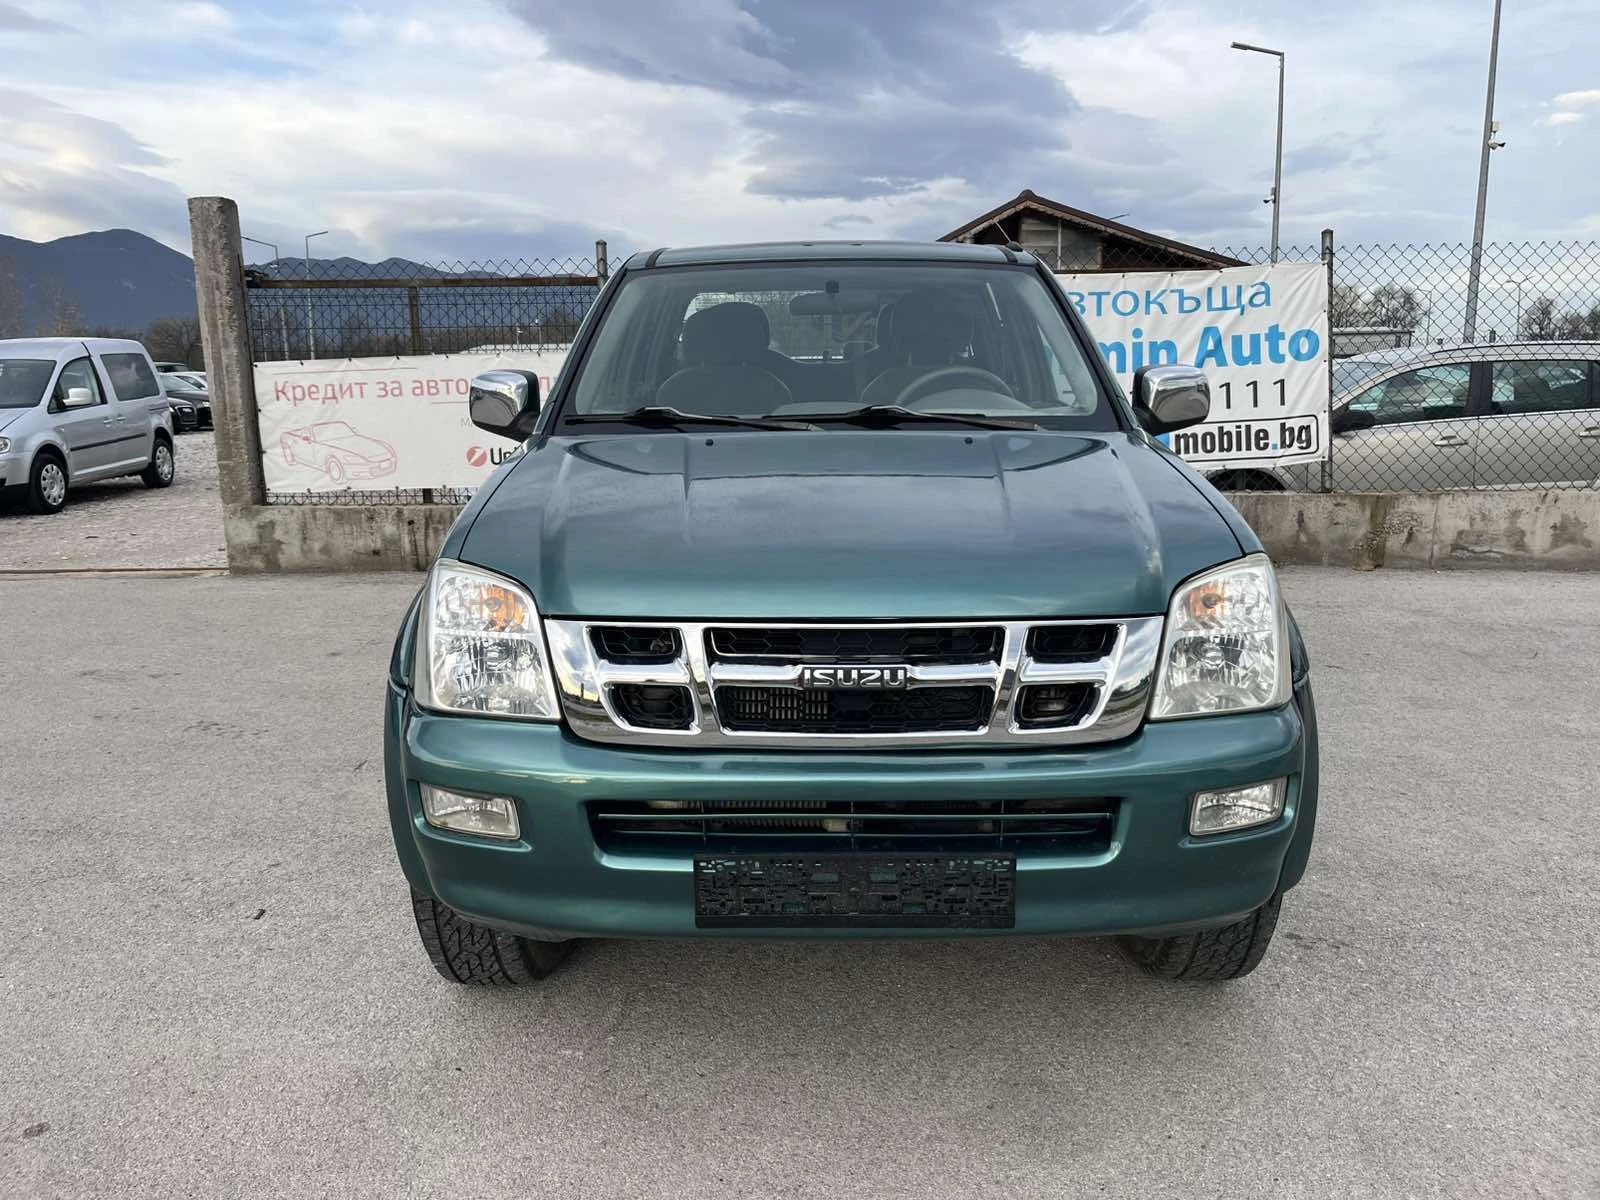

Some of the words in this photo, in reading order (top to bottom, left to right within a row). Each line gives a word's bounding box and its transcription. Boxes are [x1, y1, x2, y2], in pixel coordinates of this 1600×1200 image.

[1194, 324, 1320, 369] Auto
[274, 379, 369, 408] Кредит
[376, 381, 404, 398] за
[1174, 422, 1312, 455] mobile.bg
[803, 668, 905, 688] ISUZU
